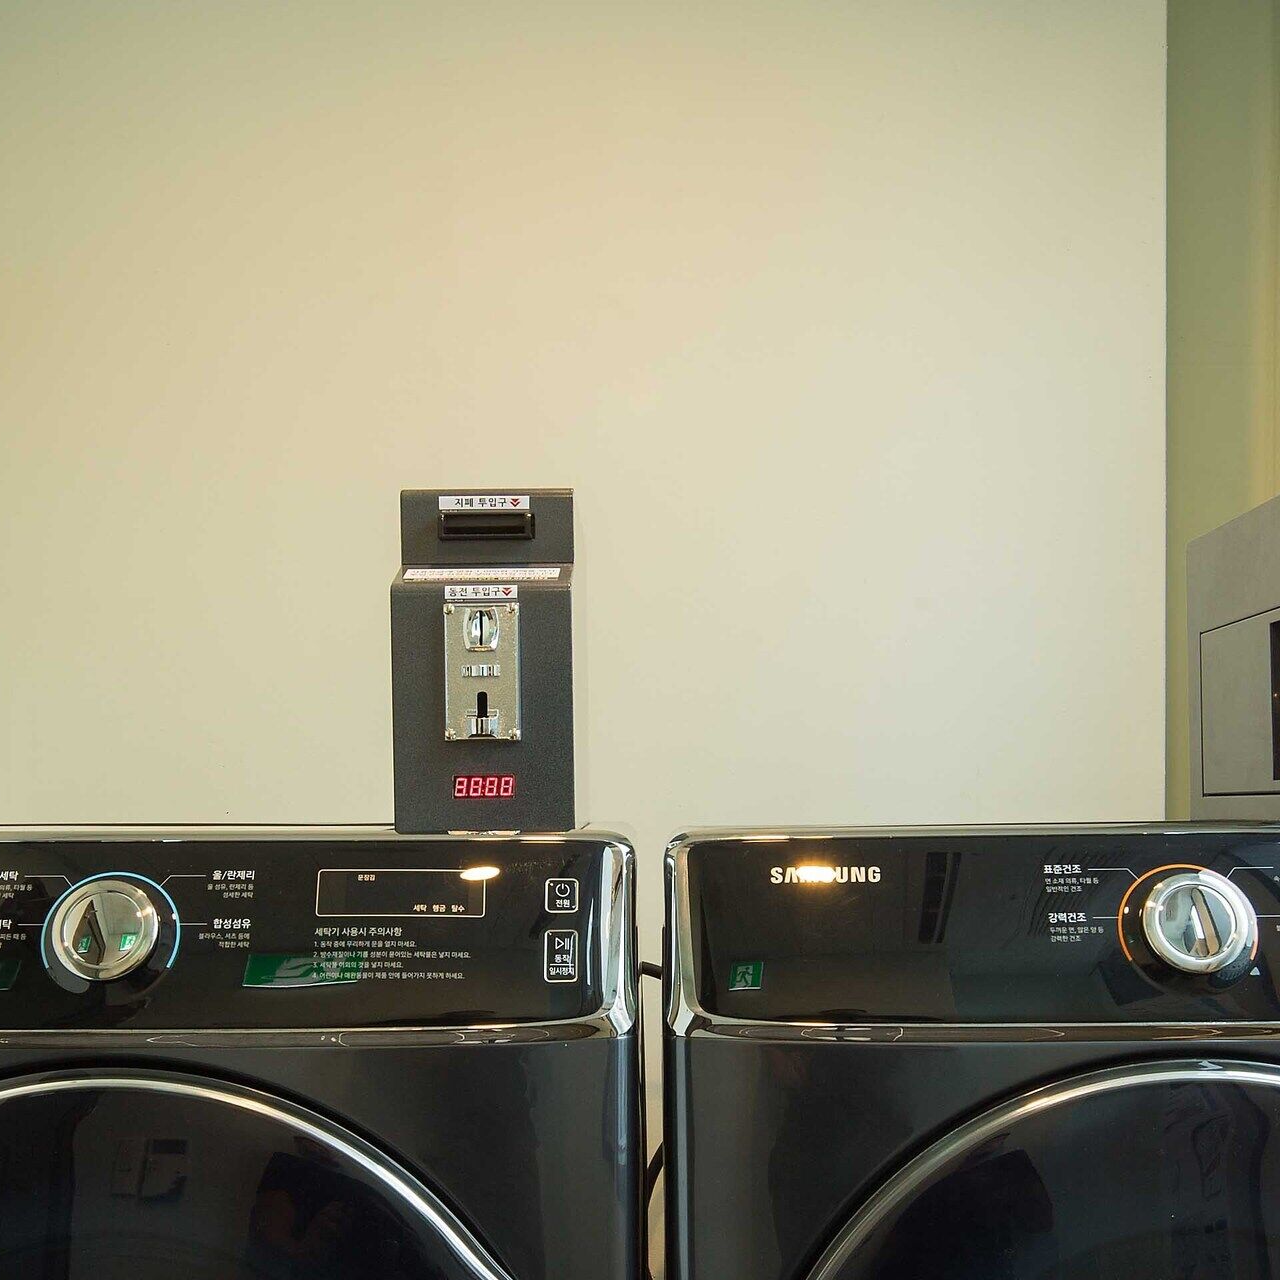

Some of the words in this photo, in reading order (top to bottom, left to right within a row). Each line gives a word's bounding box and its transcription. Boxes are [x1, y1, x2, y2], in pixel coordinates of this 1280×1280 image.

[454, 498, 474, 507] 지폐
[477, 498, 507, 507] 투입구
[448, 587, 467, 597] 동전
[472, 587, 500, 597] 투입구
[1043, 864, 1082, 875] 표준건조
[212, 870, 255, 880] 울/란제리
[770, 866, 881, 884] SAUNG
[412, 904, 428, 913] 세탁
[451, 904, 466, 913] 탈수
[555, 899, 570, 908] 전원
[1048, 912, 1087, 924] 강력건조
[213, 918, 252, 930] 합성섬유
[314, 926, 340, 937] 세탁기
[341, 926, 367, 937] 사용시
[368, 926, 403, 937] 주의사항
[554, 954, 571, 963] 동작
